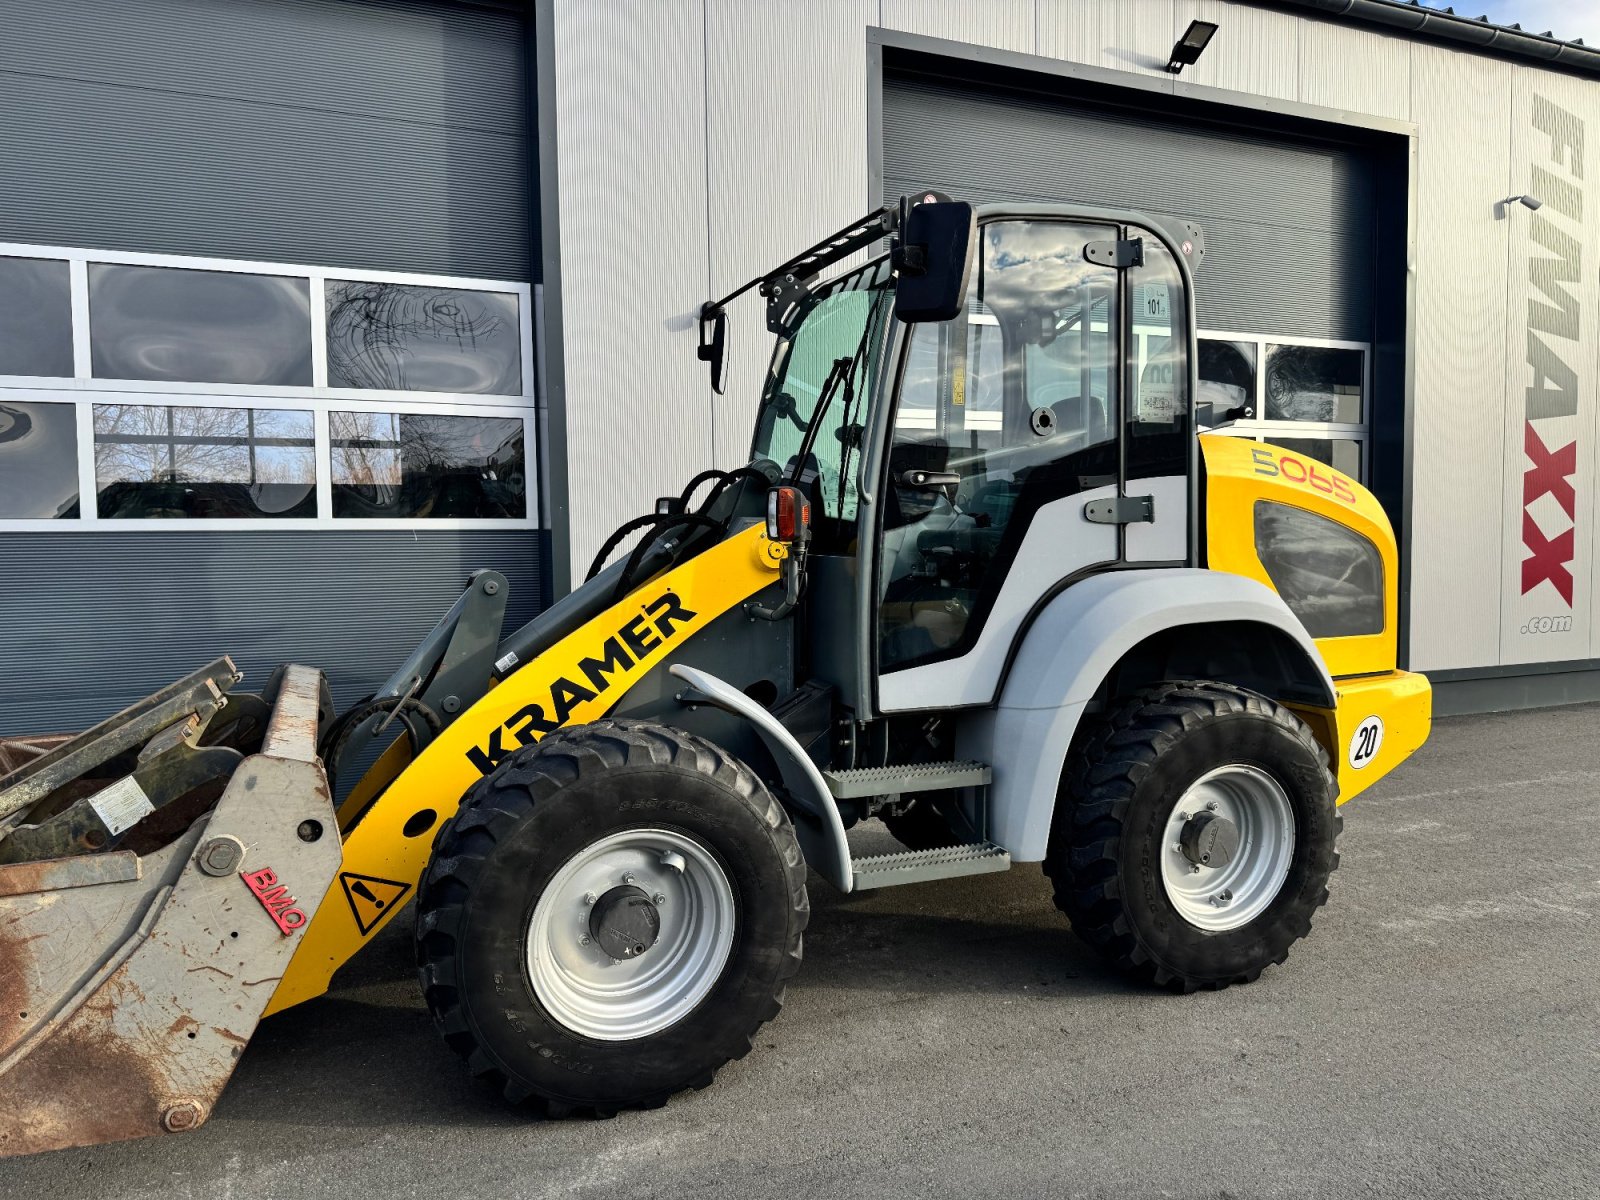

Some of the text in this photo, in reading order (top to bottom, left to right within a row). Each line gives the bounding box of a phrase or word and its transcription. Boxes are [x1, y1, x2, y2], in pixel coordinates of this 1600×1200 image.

[1147, 298, 1160, 315] 101
[1521, 92, 1585, 610] FIMAXX
[1251, 448, 1356, 504] 5065
[1520, 615, 1572, 635] .com
[465, 592, 698, 776] KRAMER
[1354, 724, 1378, 761] 20
